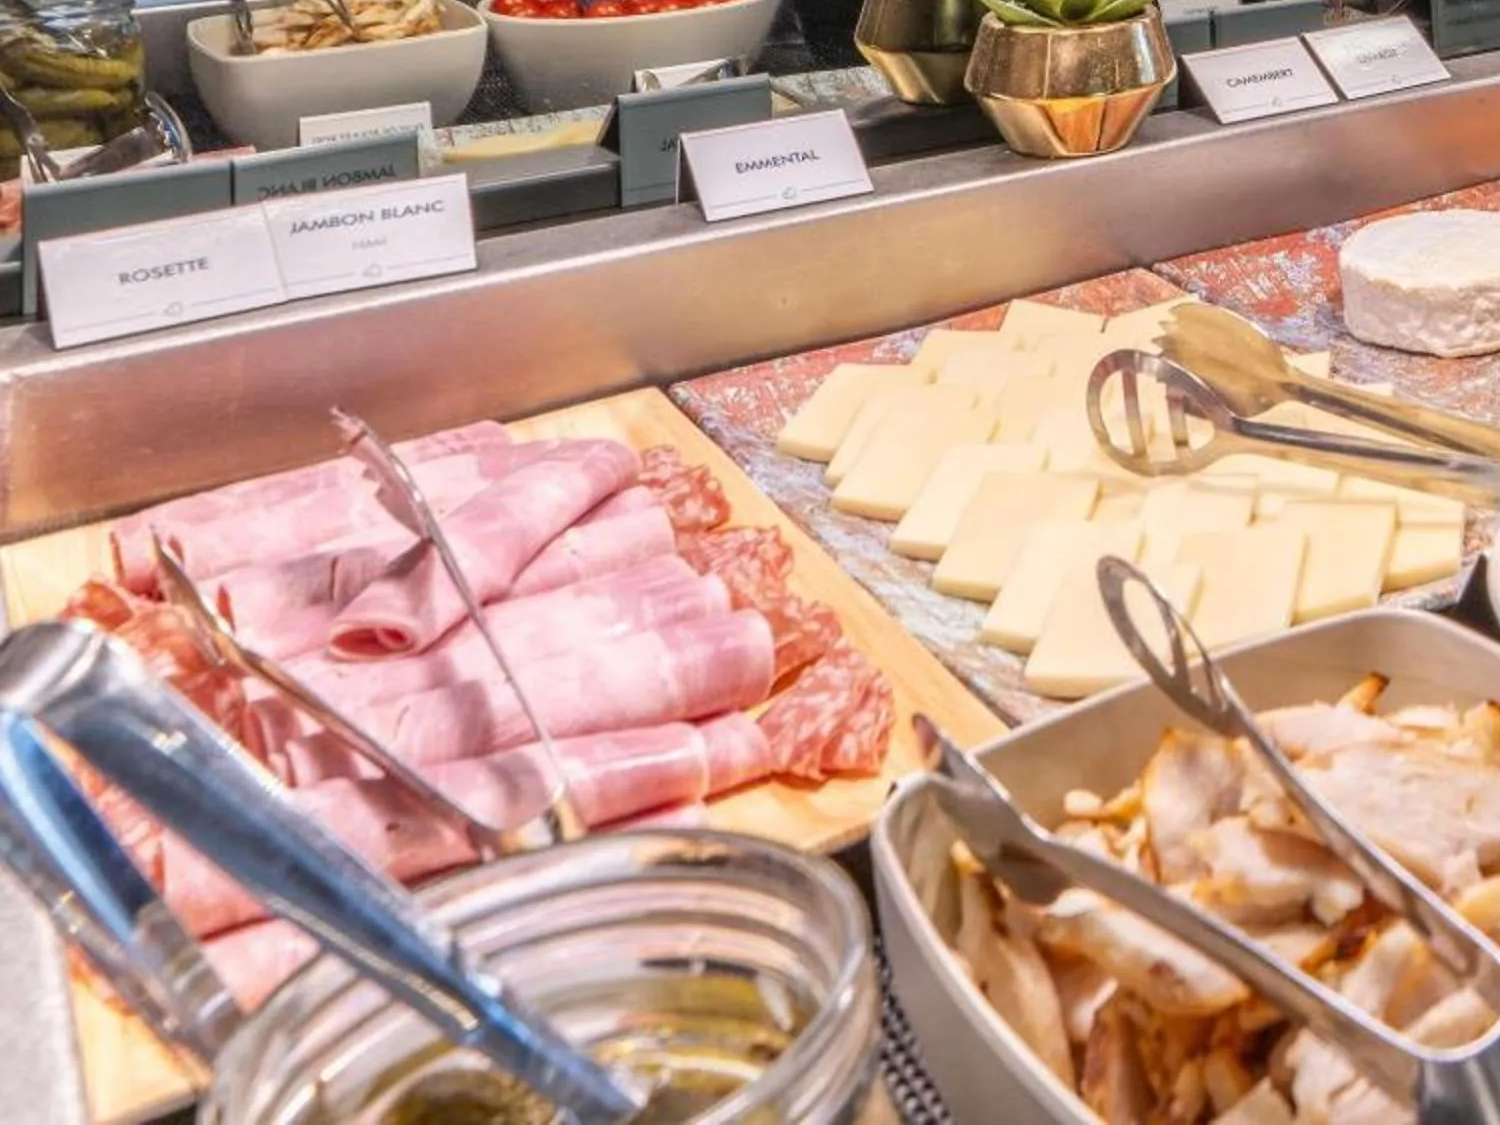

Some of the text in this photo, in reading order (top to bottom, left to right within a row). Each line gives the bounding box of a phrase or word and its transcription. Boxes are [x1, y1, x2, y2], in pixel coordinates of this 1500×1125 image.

[1226, 67, 1294, 88] CAMEMBERT
[734, 148, 822, 175] EMMENTAL
[289, 199, 445, 236] JAMBON BLANC
[117, 256, 209, 286] ROSETTE
